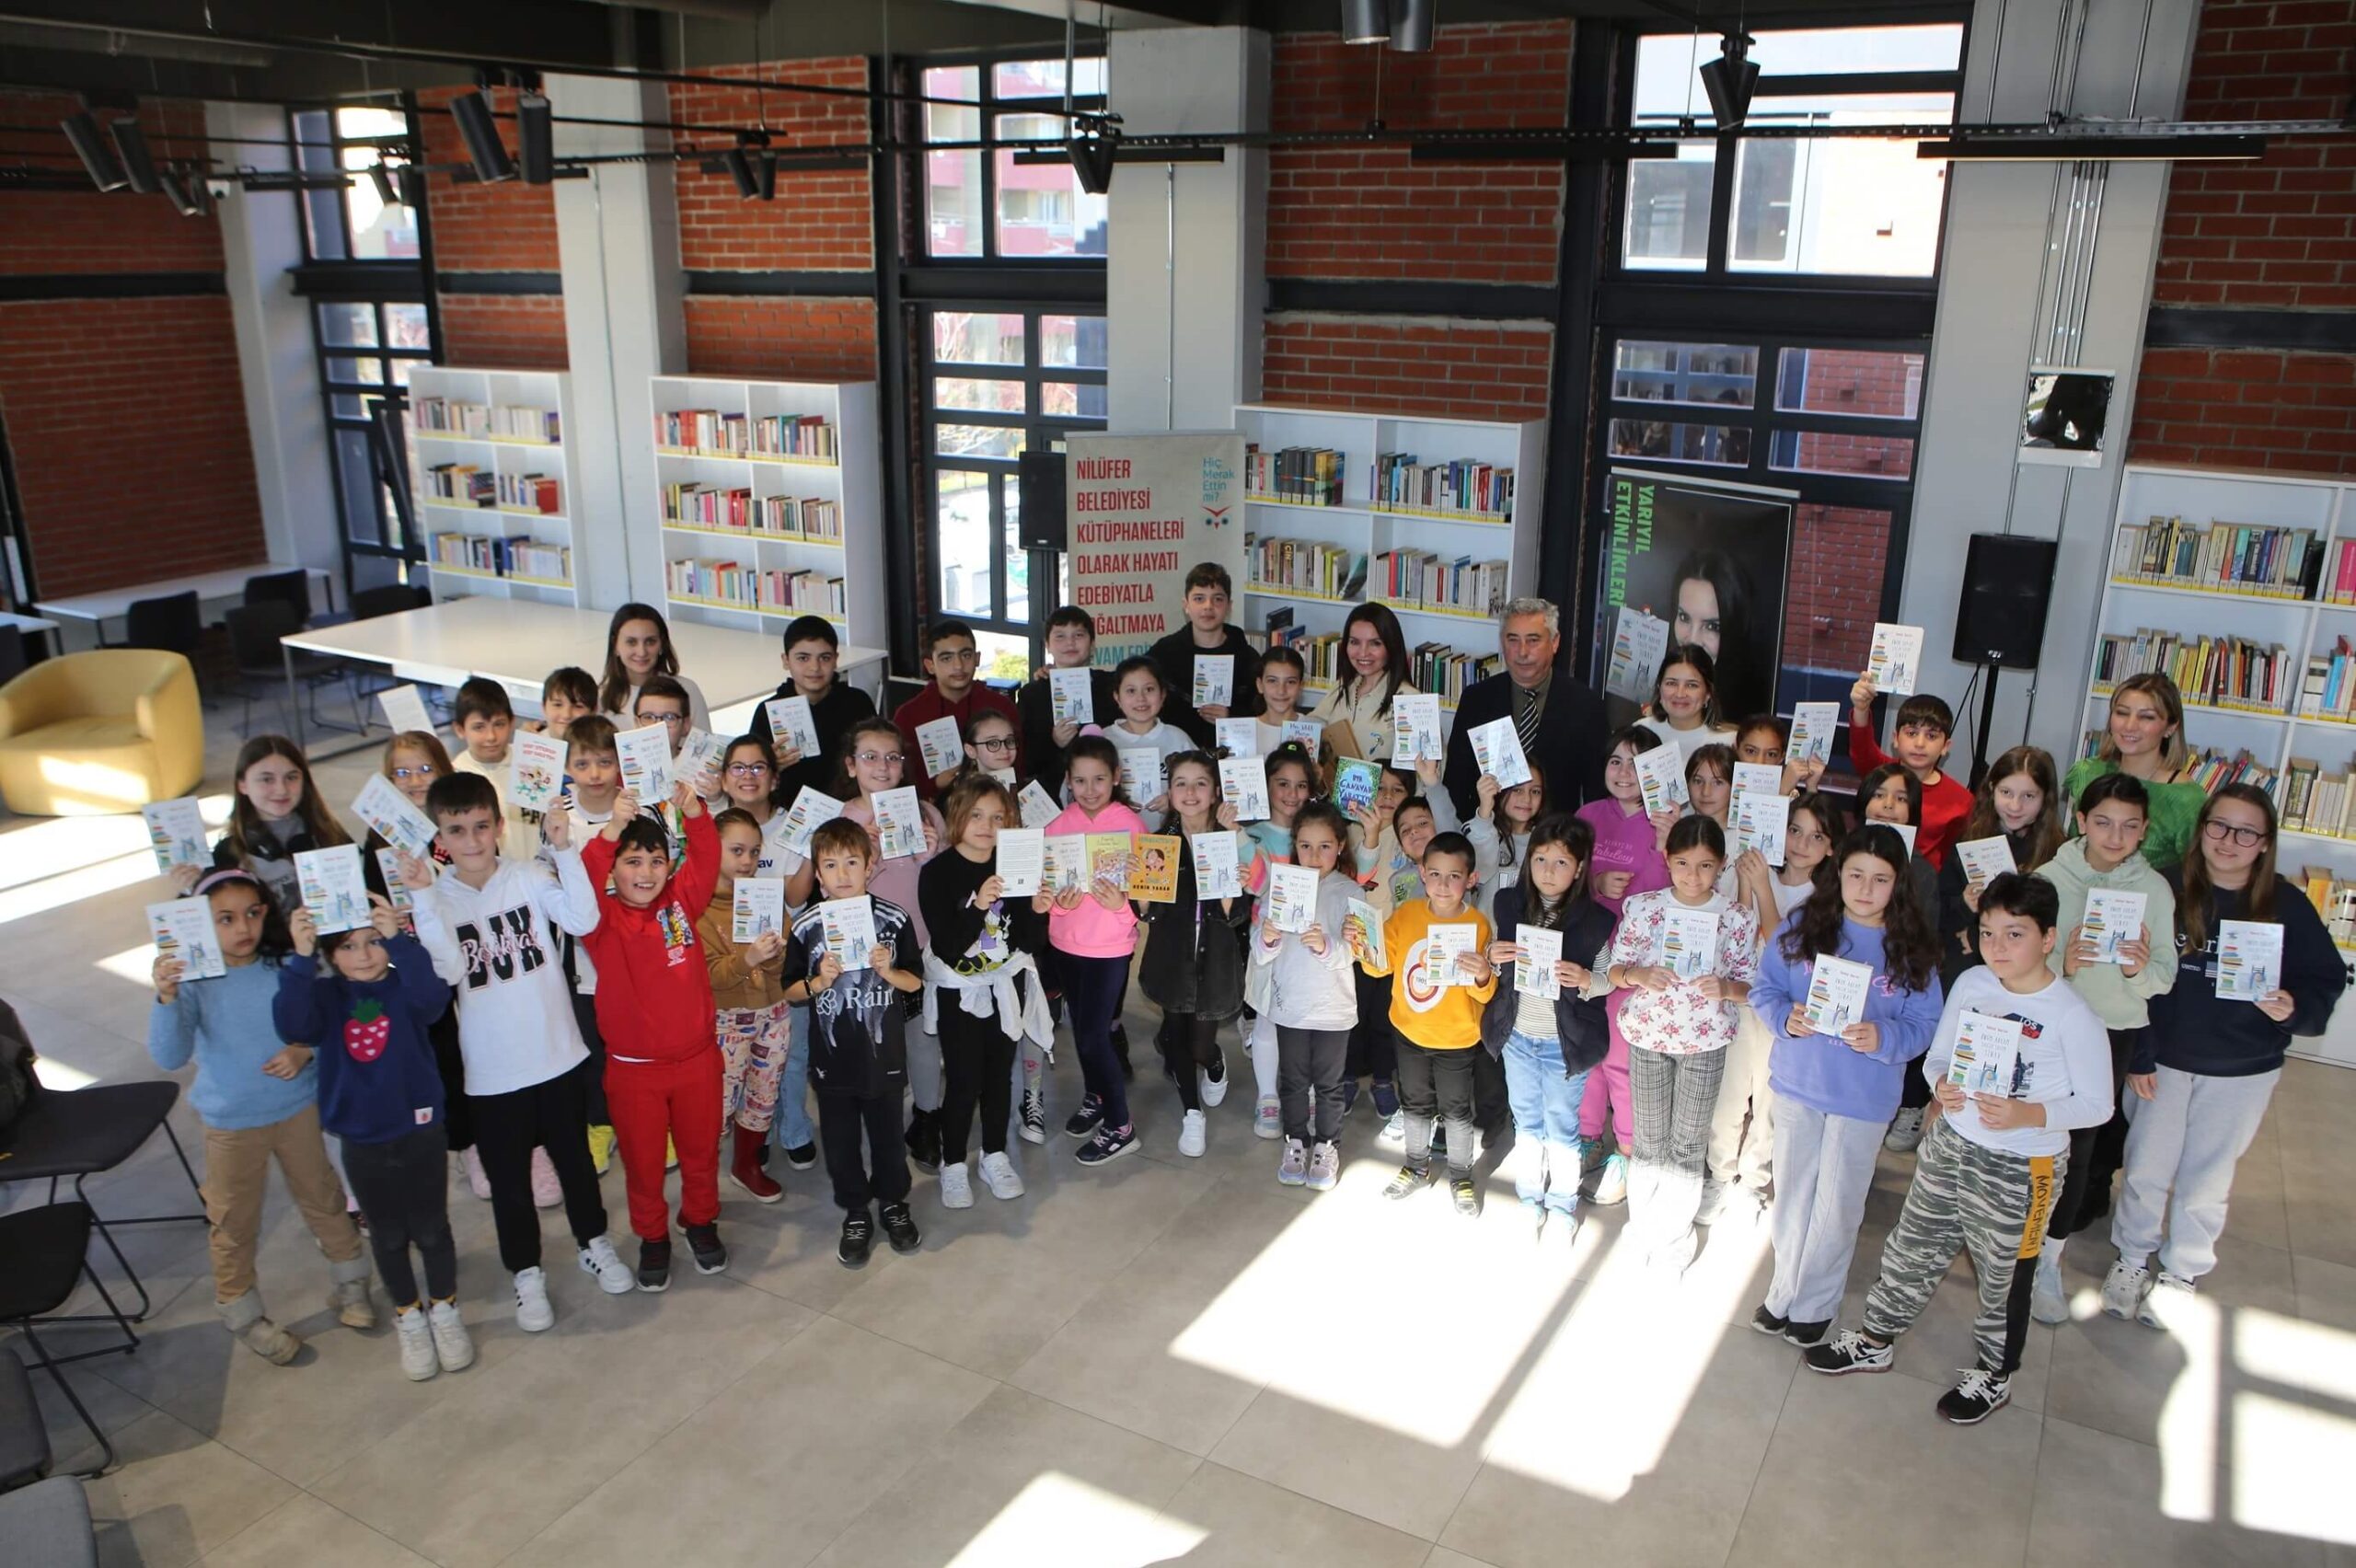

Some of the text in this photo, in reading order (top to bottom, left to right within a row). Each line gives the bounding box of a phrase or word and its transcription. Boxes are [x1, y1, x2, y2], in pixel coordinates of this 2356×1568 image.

[1077, 456, 1131, 479] NİLÜFER
[1077, 487, 1150, 511] BELEDİYESİ
[1077, 517, 1184, 543] KÜTÜPHANELERİ
[1635, 485, 1655, 554] YARIYIL
[1609, 481, 1633, 607] ETKİNLİKLERİ
[1077, 551, 1178, 574] OLARAK HAYATI
[1078, 582, 1153, 605] EDEBİYATLA
[844, 985, 894, 1009] Rain
